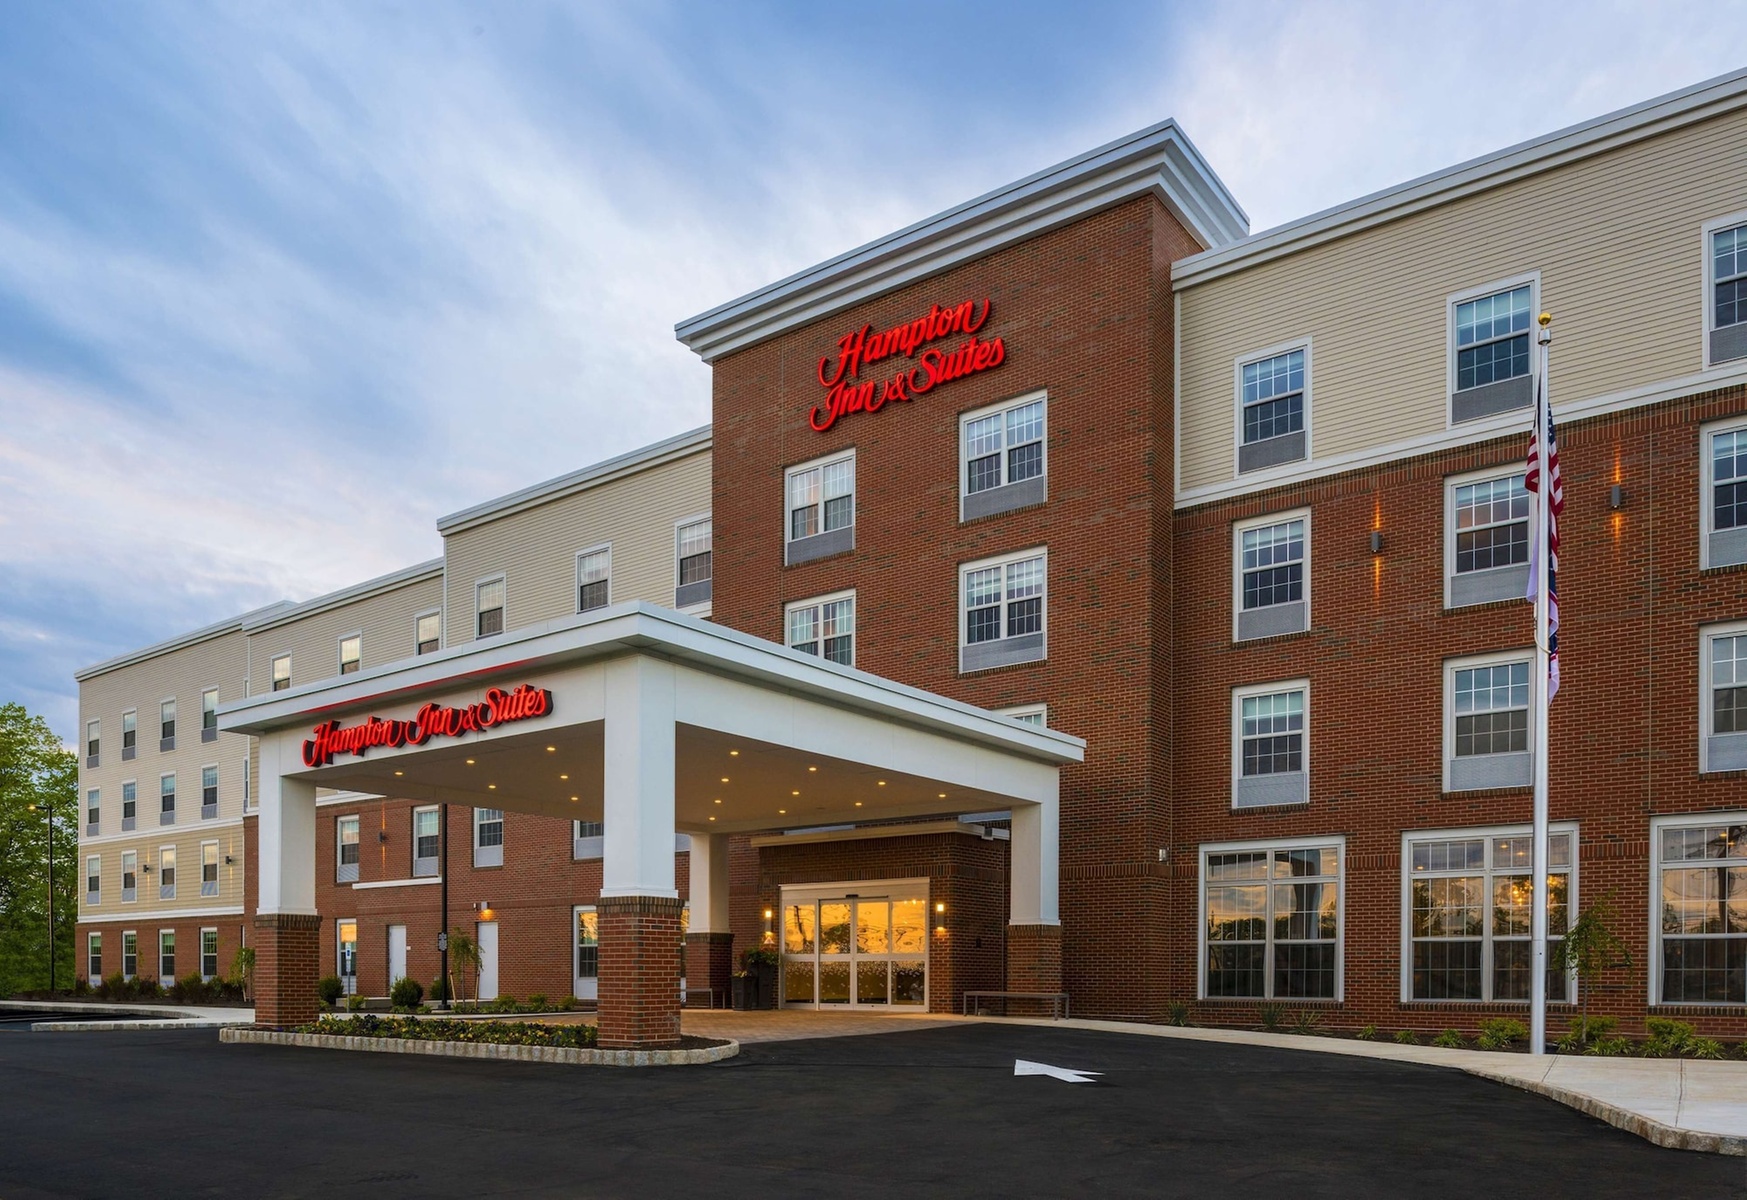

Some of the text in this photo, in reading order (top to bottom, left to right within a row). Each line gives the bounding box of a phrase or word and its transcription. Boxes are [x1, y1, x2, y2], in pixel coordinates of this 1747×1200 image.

[809, 336, 1006, 432] Inn & Suites
[818, 298, 991, 388] Hampton
[302, 684, 551, 768] Hampton Inn & Suites
